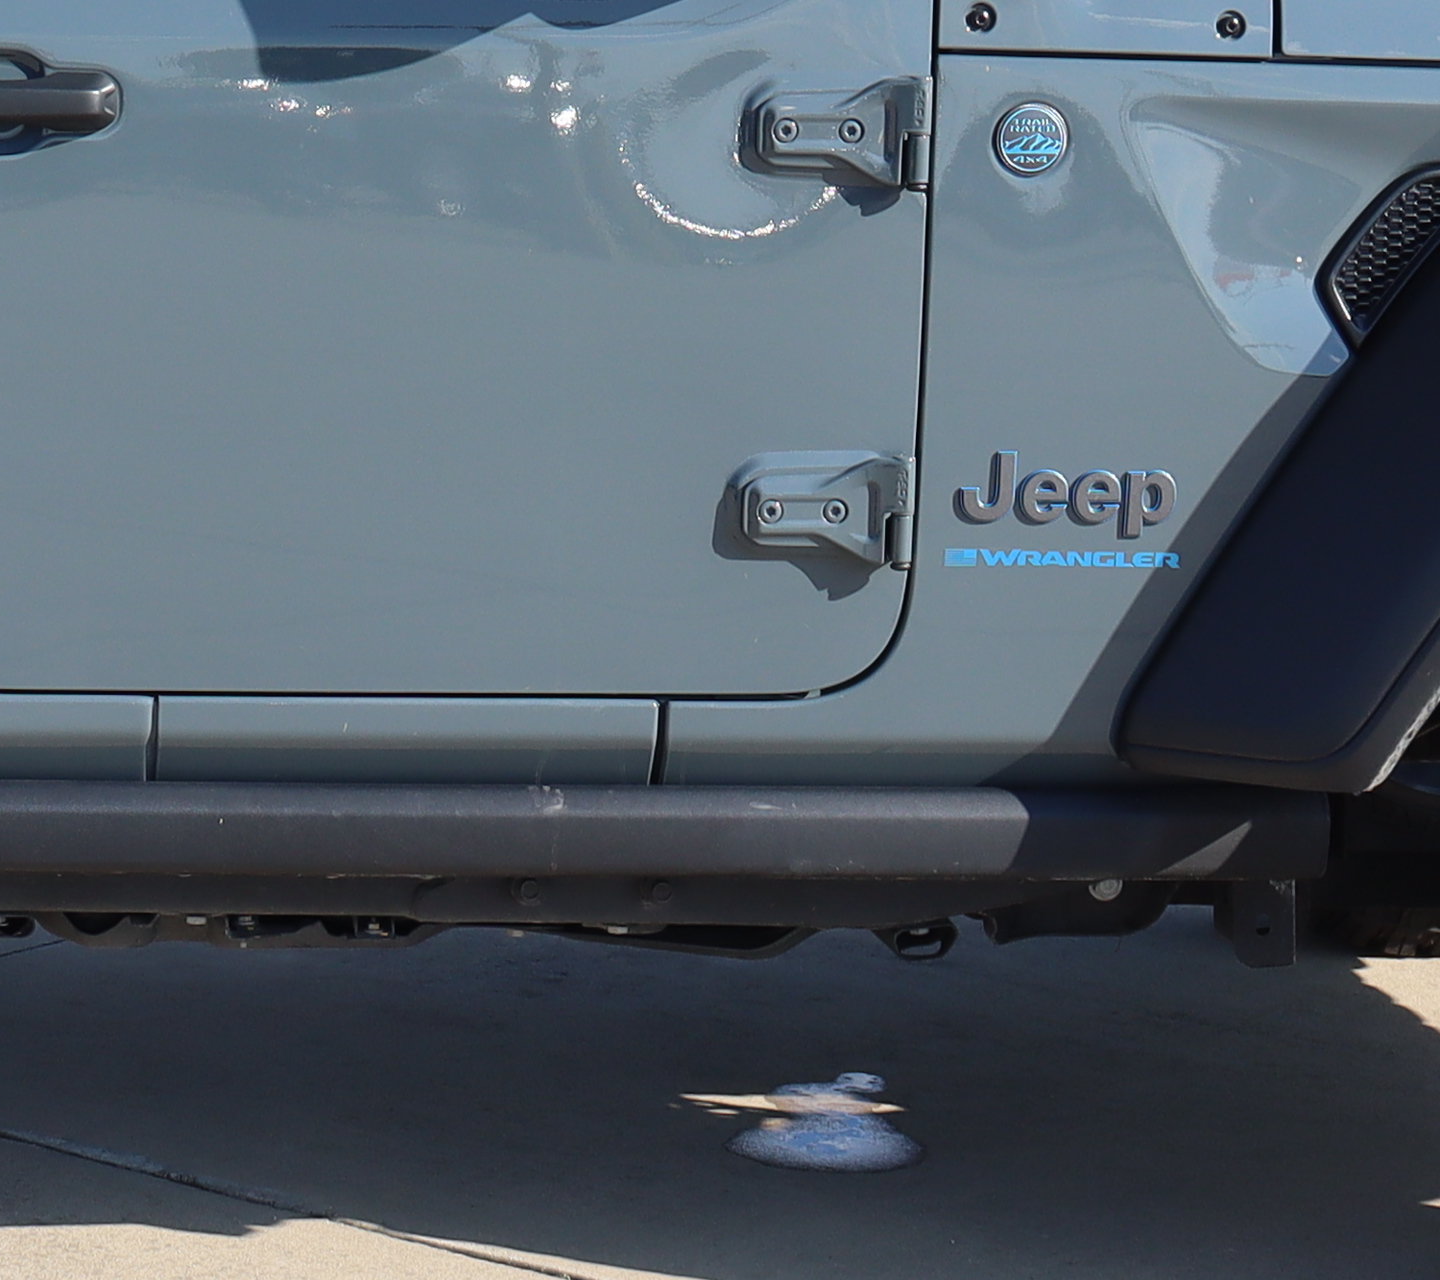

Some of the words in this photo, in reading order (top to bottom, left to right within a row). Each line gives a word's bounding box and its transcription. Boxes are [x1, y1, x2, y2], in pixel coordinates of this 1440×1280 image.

[1010, 124, 1056, 133] RATED
[1013, 118, 1053, 126] TRAIL
[954, 449, 1178, 539] Jeep
[978, 548, 1181, 569] WRANGLER
